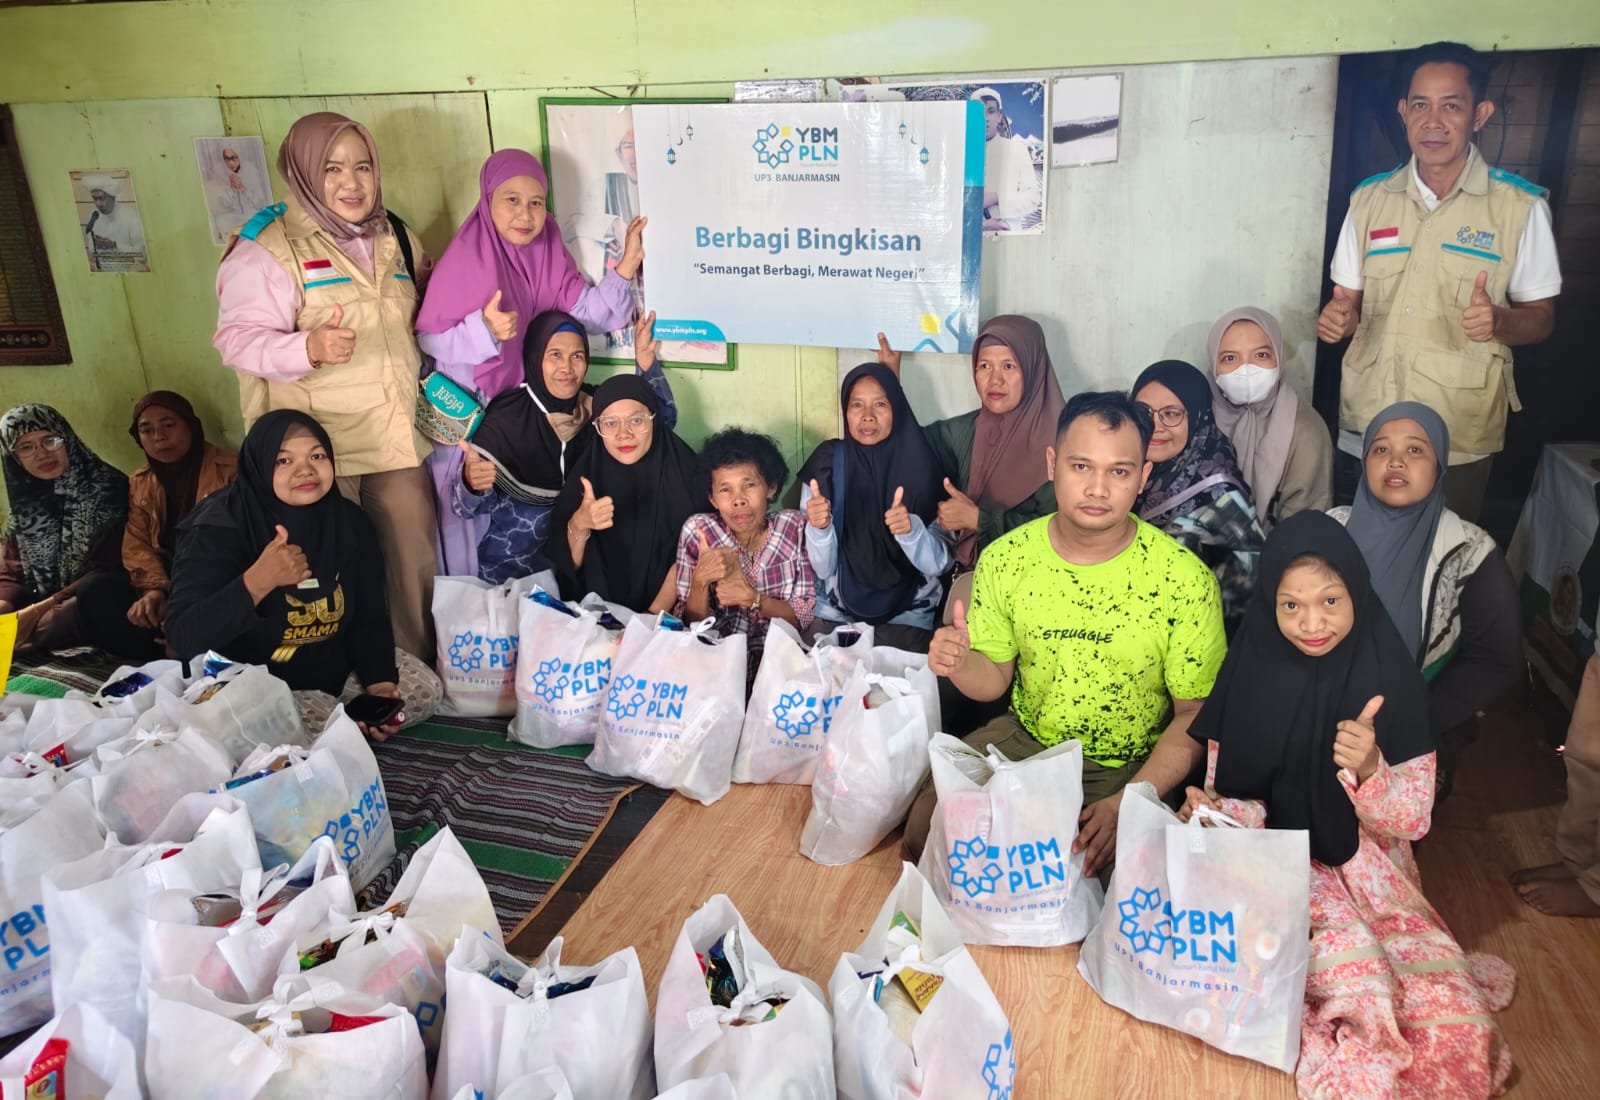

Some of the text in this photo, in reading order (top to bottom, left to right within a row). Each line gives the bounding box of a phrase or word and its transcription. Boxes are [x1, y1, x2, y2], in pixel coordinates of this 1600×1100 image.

[795, 127, 838, 143] YBM
[799, 145, 838, 160] PLN
[754, 173, 840, 182] UP3 BANJARMASIN
[695, 226, 922, 256] Berbagi Bingkisan
[693, 263, 925, 281] “Semangat Berbagi, Merawat Negeri”
[283, 622, 339, 640] SMAMA
[1042, 629, 1114, 643] STRUGGLE
[489, 653, 519, 668] PL
[652, 682, 688, 700] YBM
[646, 700, 683, 719] PLN
[350, 776, 381, 821] YBM
[362, 794, 386, 841] PLN
[1006, 837, 1061, 868] YBM
[1008, 861, 1065, 893] PLN
[1170, 909, 1235, 936] YBM
[3, 938, 50, 971] PL
[1171, 936, 1237, 963] PLN
[1138, 960, 1240, 992] Banjarmasin
